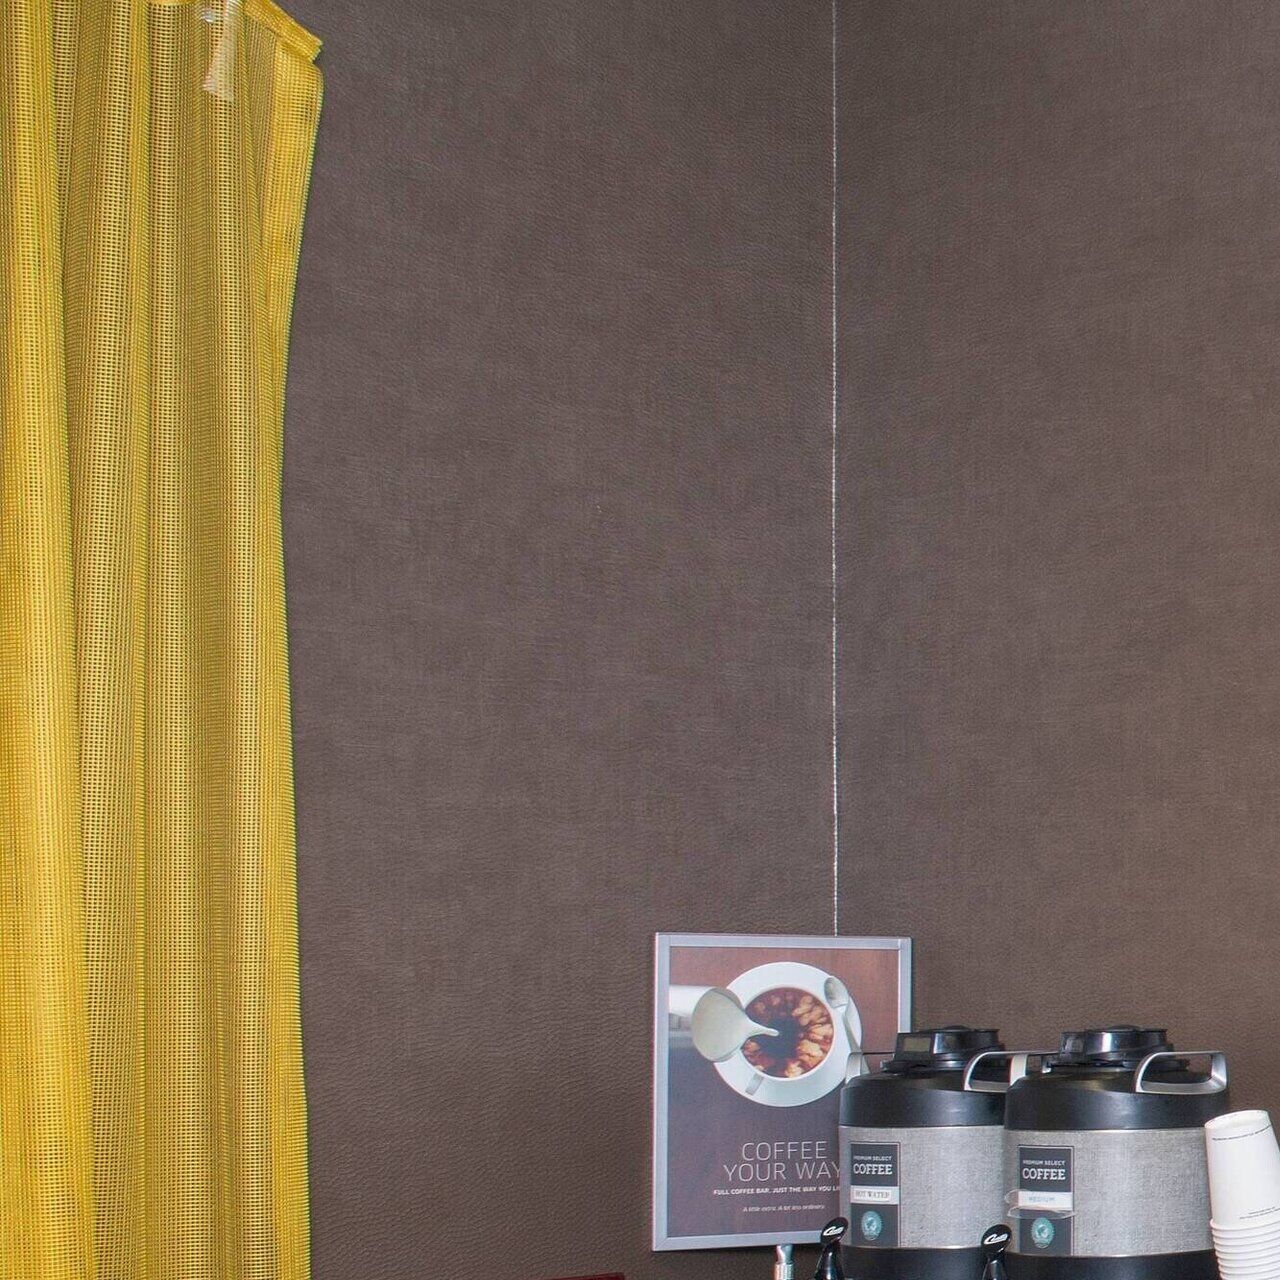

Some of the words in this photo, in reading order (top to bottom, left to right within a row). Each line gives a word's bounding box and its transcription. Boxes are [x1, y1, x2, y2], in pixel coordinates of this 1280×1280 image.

[742, 1141, 828, 1161] COFFEE
[723, 1162, 787, 1182] YOUR
[795, 1161, 840, 1180] WAY
[853, 1163, 893, 1175] COFFEE
[1022, 1167, 1066, 1180] COFFEE
